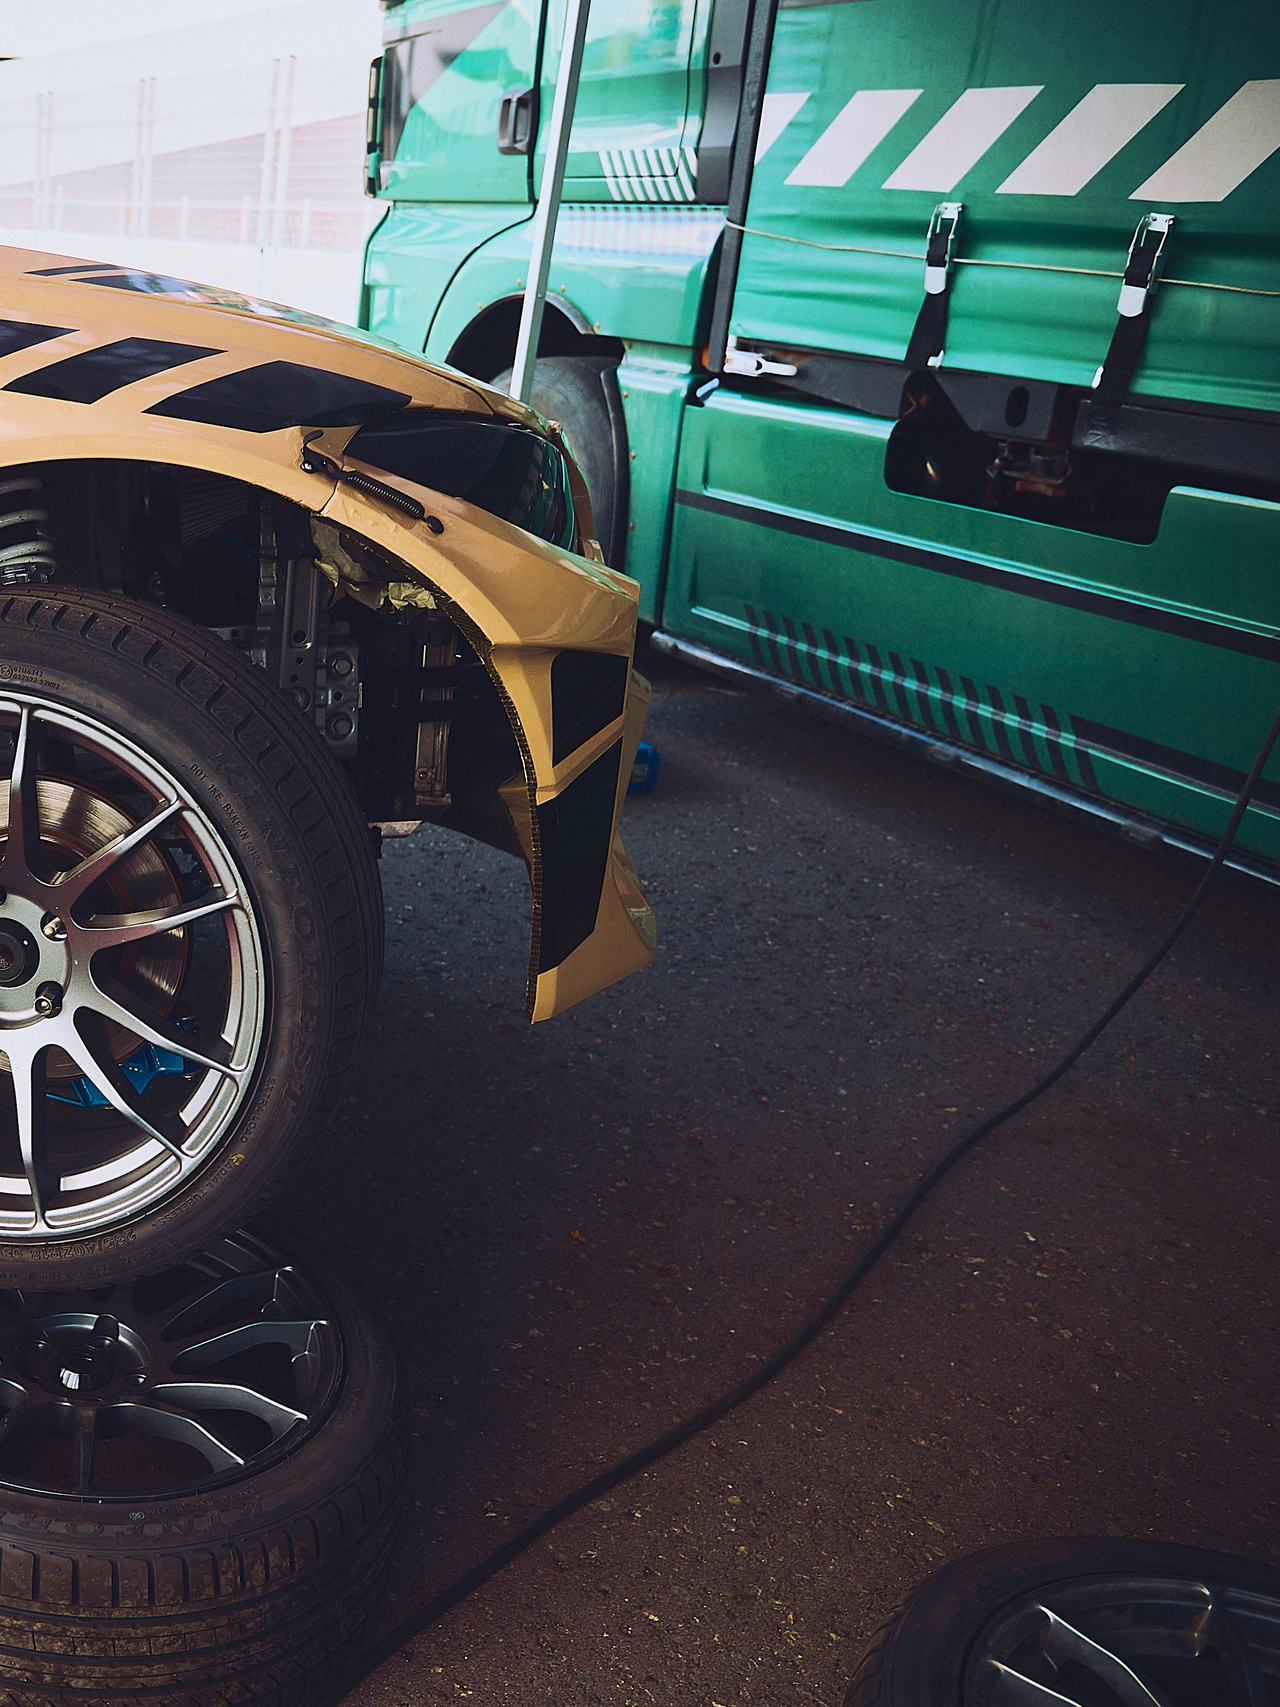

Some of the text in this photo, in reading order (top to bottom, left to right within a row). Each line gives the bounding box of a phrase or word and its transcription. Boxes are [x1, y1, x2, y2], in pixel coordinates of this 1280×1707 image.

[188, 761, 208, 782] DOT
[206, 781, 224, 801] 1KE
[237, 1075, 276, 1145] EXTRA LOAD
[156, 1186, 208, 1227] TUBELESS
[29, 1225, 138, 1260] 235/40ZR18
